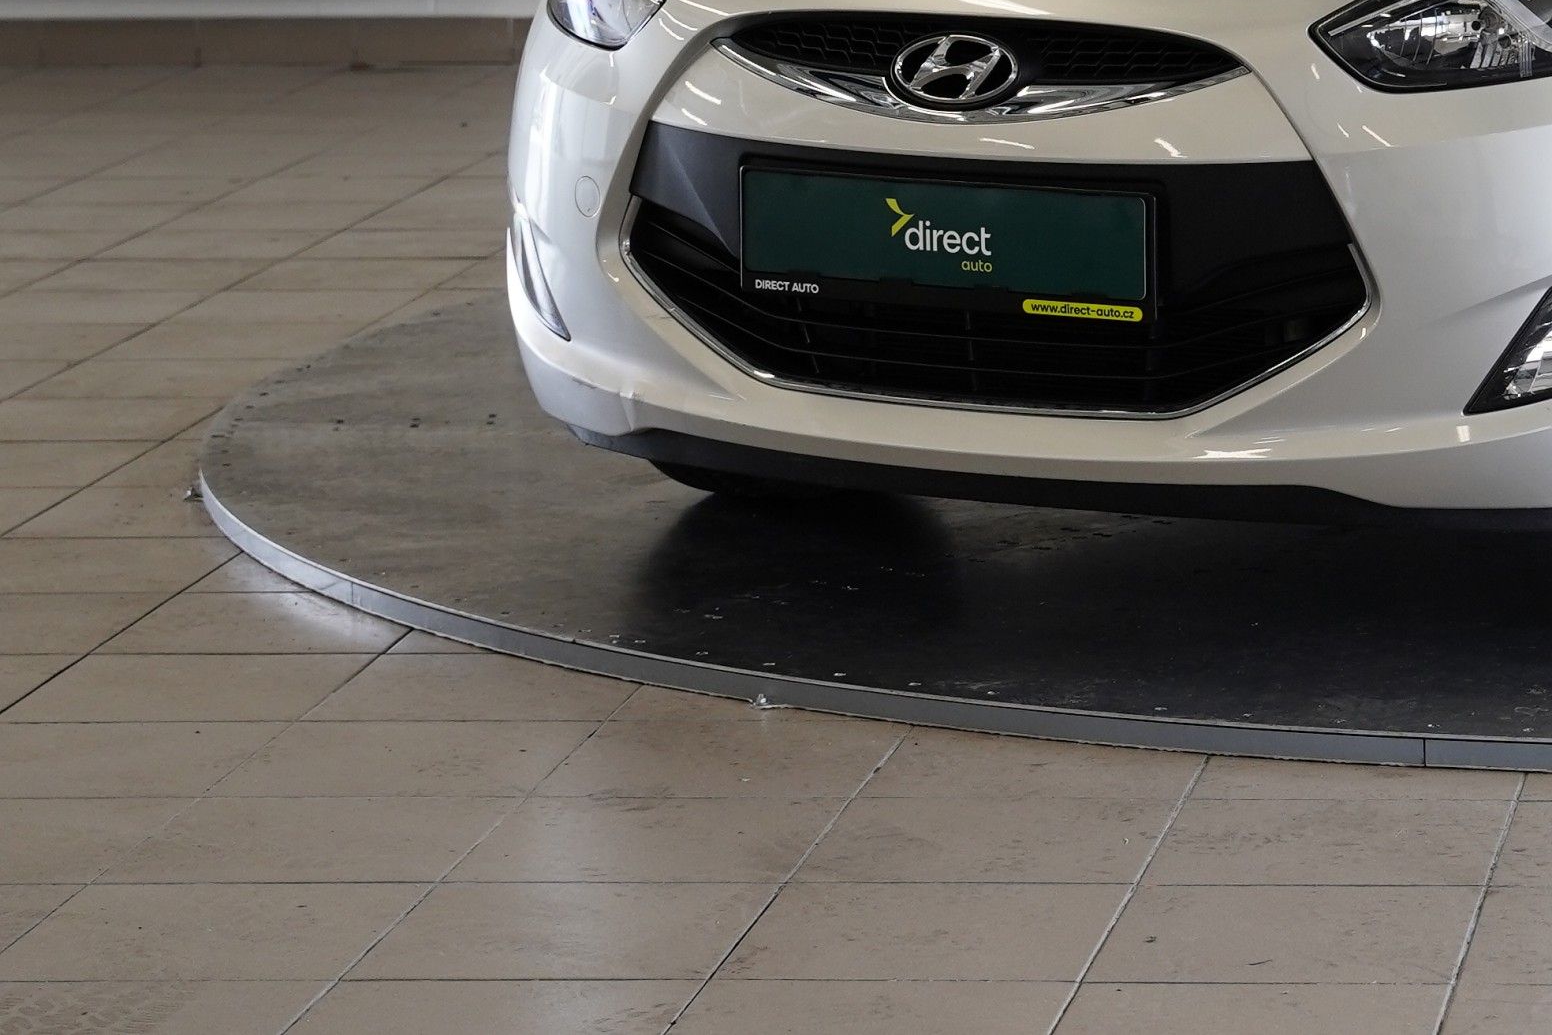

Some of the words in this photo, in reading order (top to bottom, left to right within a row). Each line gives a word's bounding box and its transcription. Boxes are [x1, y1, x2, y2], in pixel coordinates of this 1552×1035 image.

[904, 220, 992, 256] direct
[961, 260, 993, 273] auto
[754, 279, 790, 291] DIRECT
[791, 282, 819, 294] AUTO
[1030, 303, 1135, 319] www.direct-auto.cz
